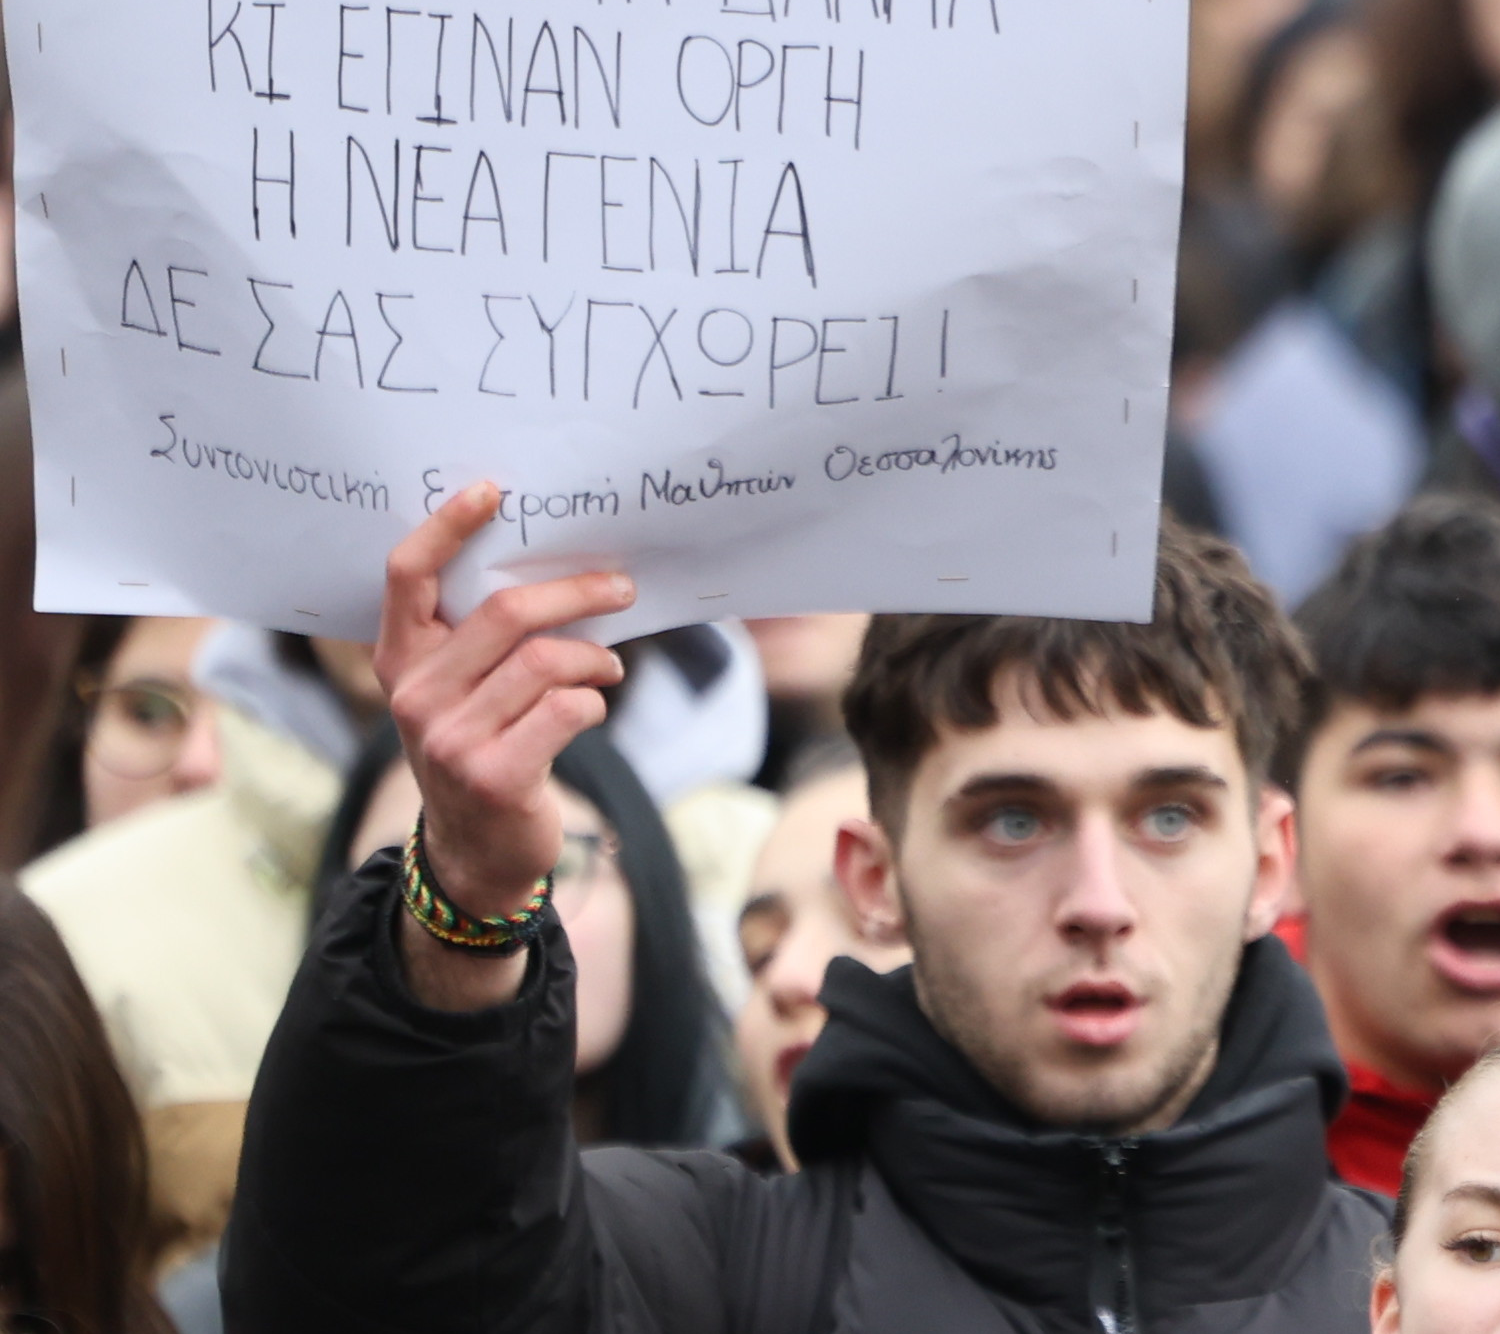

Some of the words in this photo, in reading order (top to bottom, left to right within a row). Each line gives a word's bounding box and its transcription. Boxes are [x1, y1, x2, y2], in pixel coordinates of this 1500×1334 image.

[336, 5, 624, 130] ΕΓΙΝΑΝ
[676, 35, 867, 150] ΟΡΓΗ
[251, 127, 297, 242] Η
[345, 135, 508, 257] ΝΕΑ
[542, 150, 818, 289] ΓΕΝΙΑ
[119, 260, 223, 356] ΔΕ
[246, 277, 439, 395] ΣΑΣ
[150, 415, 389, 511] Συντονιστική
[423, 468, 619, 546] Ετροπή
